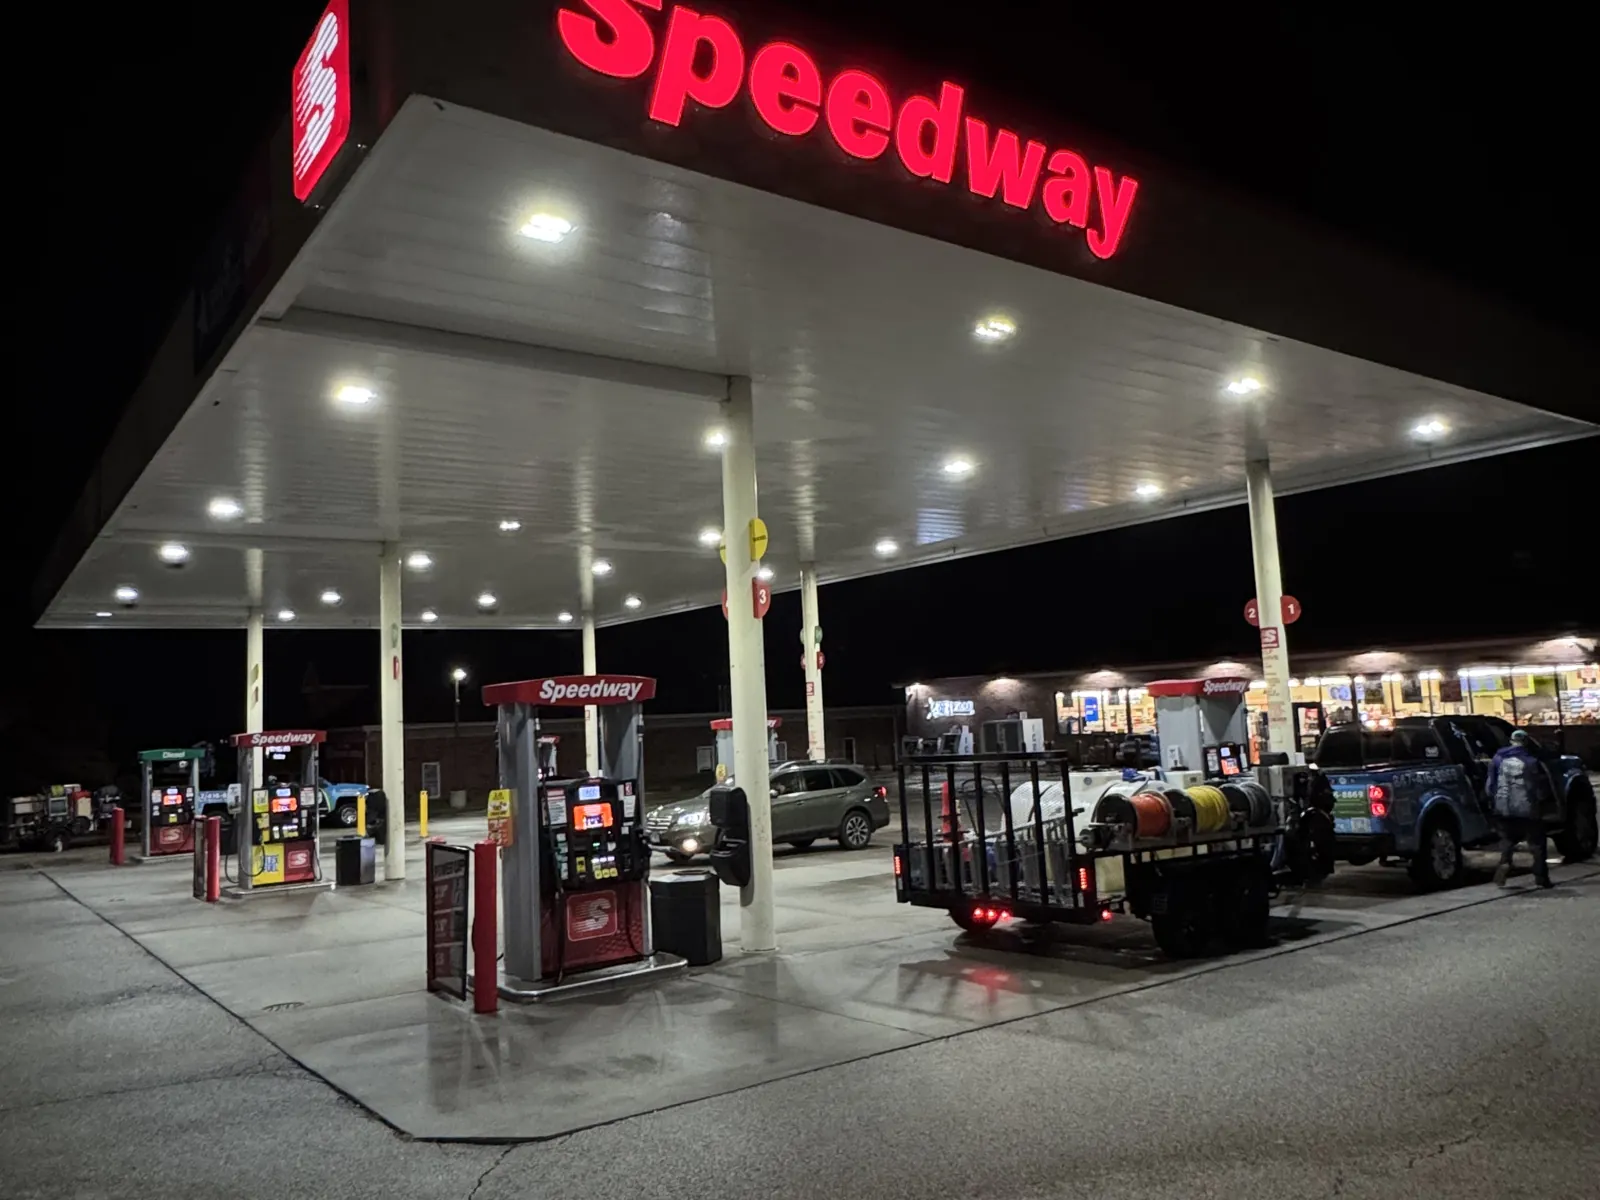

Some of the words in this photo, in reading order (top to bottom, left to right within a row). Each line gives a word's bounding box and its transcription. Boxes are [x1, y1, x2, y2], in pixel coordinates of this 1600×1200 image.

[557, 0, 1139, 260] Speedway
[758, 588, 768, 605] 3
[1248, 607, 1257, 619] 2
[1287, 603, 1295, 615] 1
[538, 678, 643, 703] Speedway
[1203, 680, 1246, 695] Speedway
[251, 732, 315, 746] Speedway
